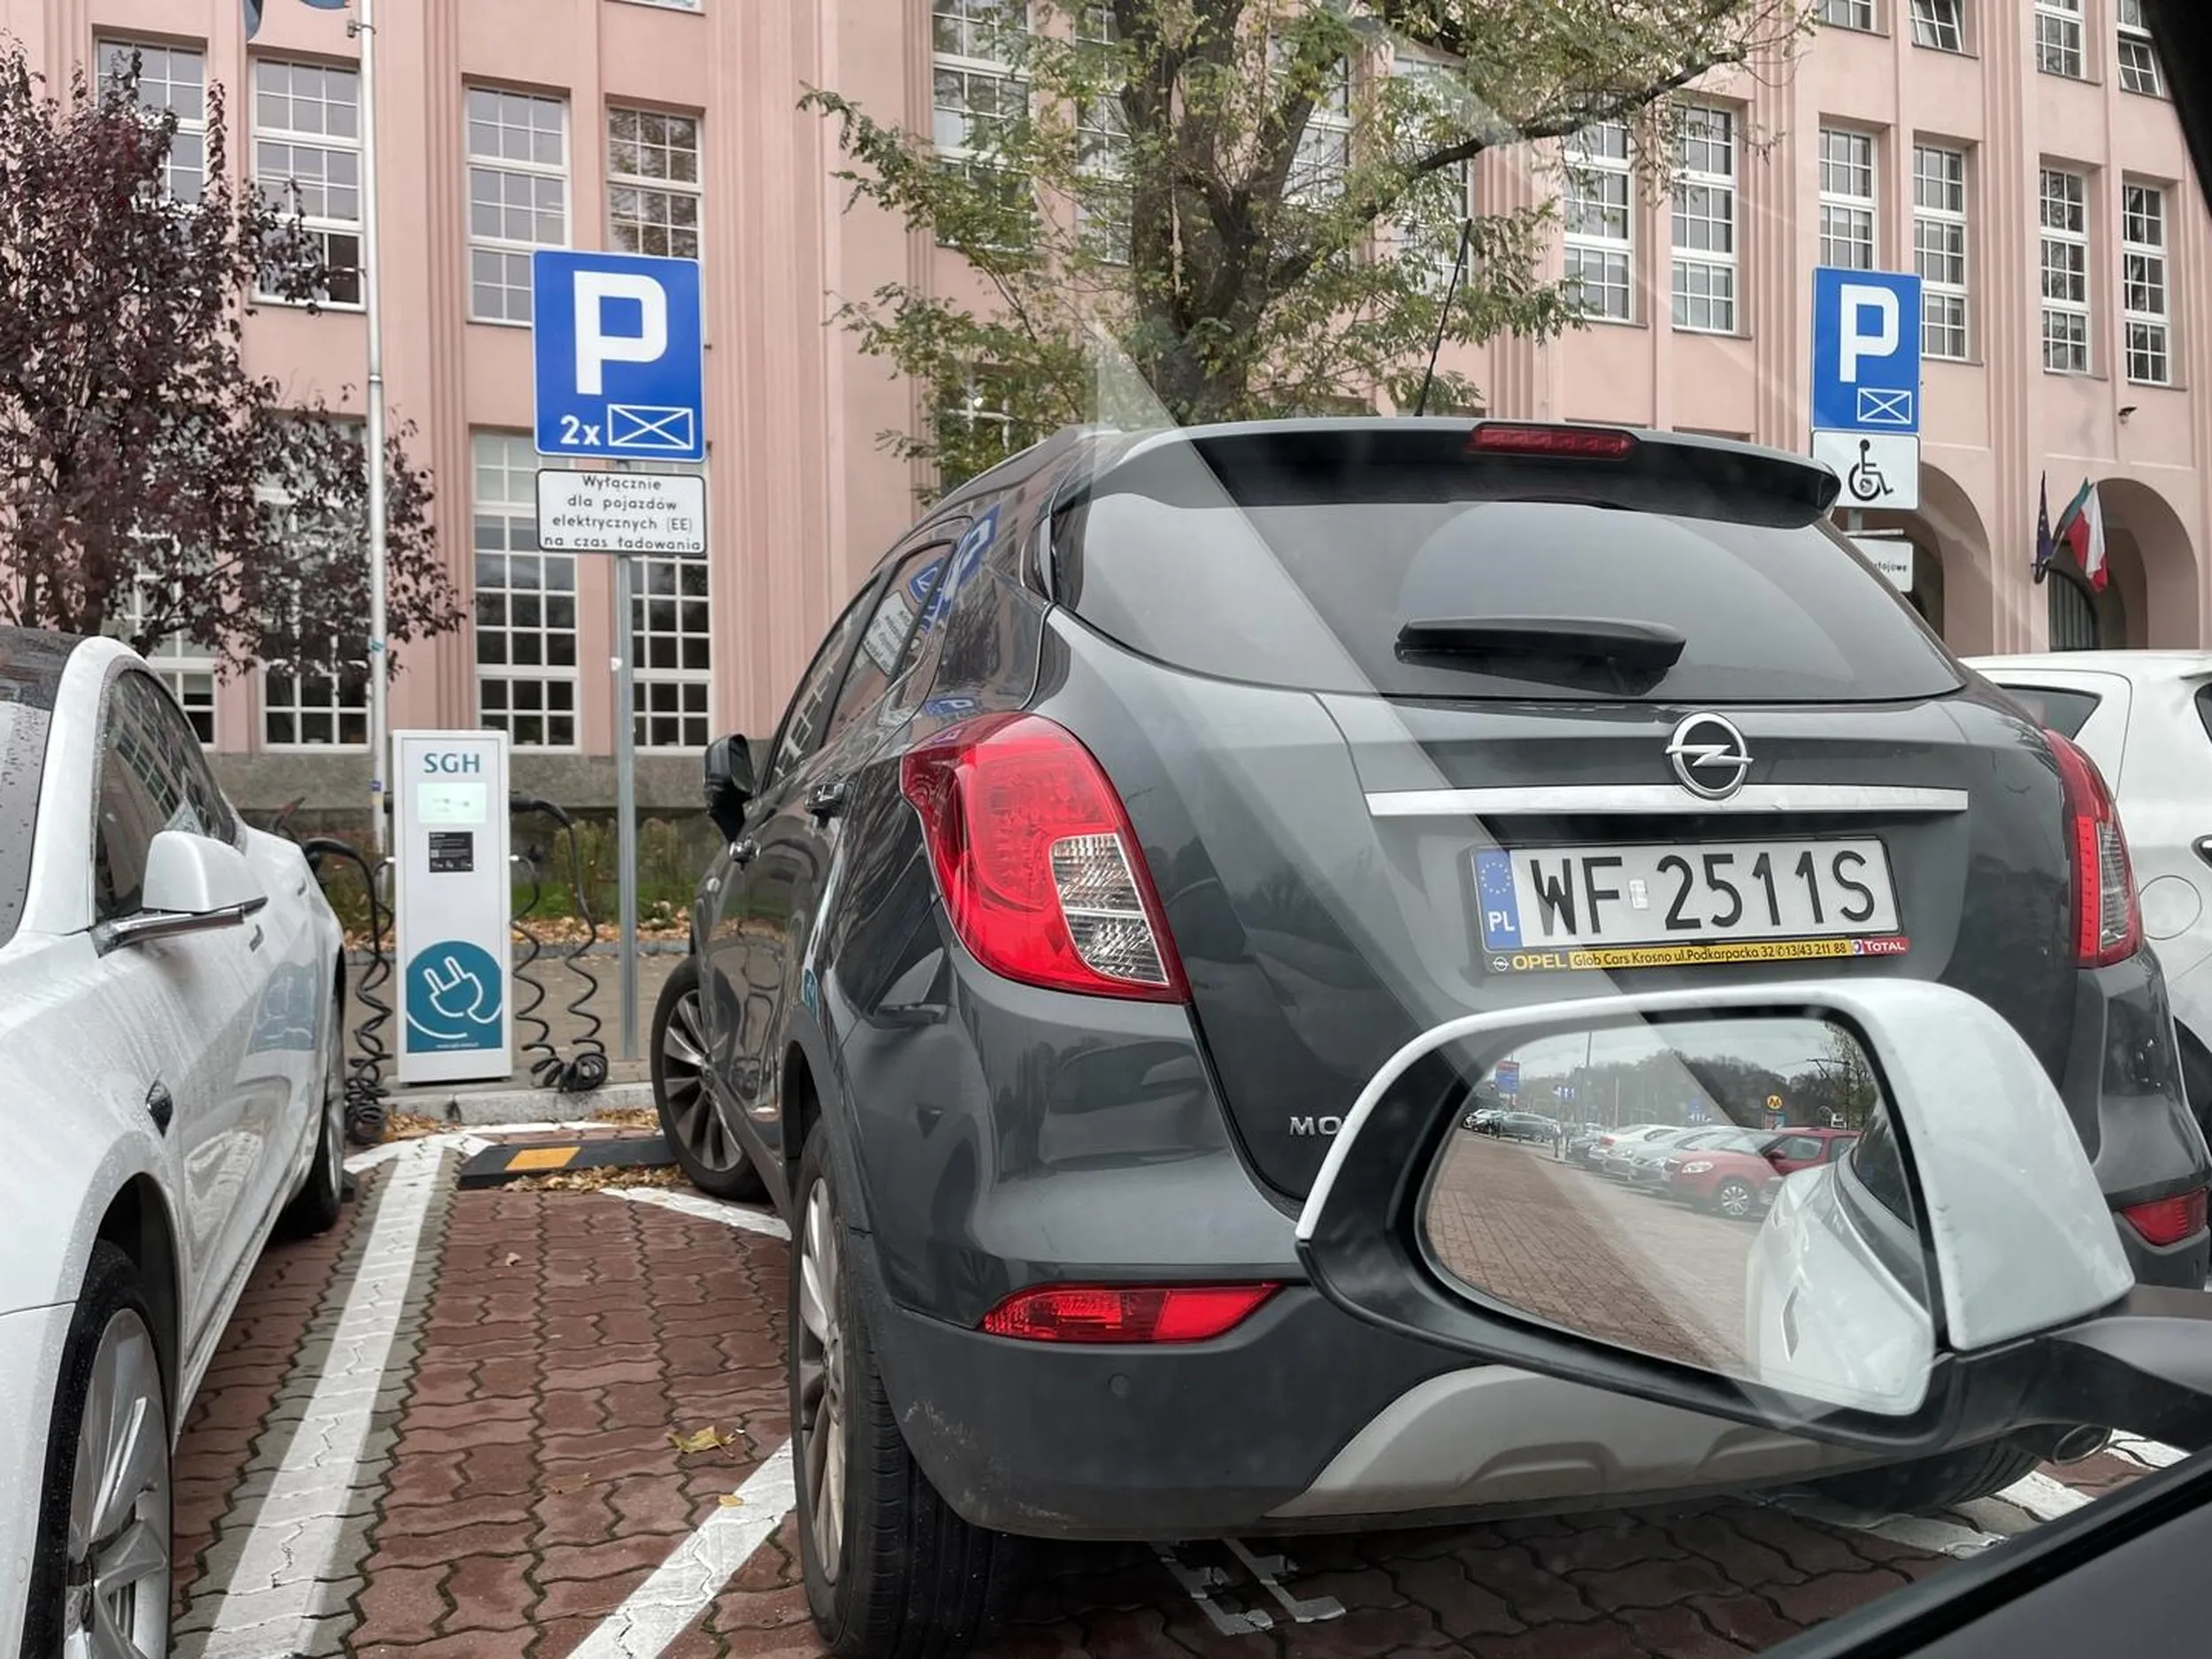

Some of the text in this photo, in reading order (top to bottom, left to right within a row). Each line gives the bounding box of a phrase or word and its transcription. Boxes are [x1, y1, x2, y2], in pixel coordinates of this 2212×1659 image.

[573, 270, 667, 396] P
[1839, 283, 1900, 383] P
[559, 415, 601, 446] 2x
[582, 475, 662, 492] Wyłącznie
[567, 495, 677, 511] dla pojazdów
[552, 514, 693, 533] elektrycznych (EE)
[544, 536, 701, 550] na czas ładowania
[424, 753, 480, 773] SGH
[1530, 850, 1876, 935] WF 2511S
[1487, 910, 1516, 933] PL
[1865, 940, 1905, 952] TOTAL
[1512, 953, 1568, 971] OPEL
[1573, 953, 1601, 967] Glob
[1604, 951, 1630, 965] Cars
[1632, 949, 1671, 964] Krosno
[1760, 946, 1774, 956] 32
[1289, 1116, 1344, 1135] MO
